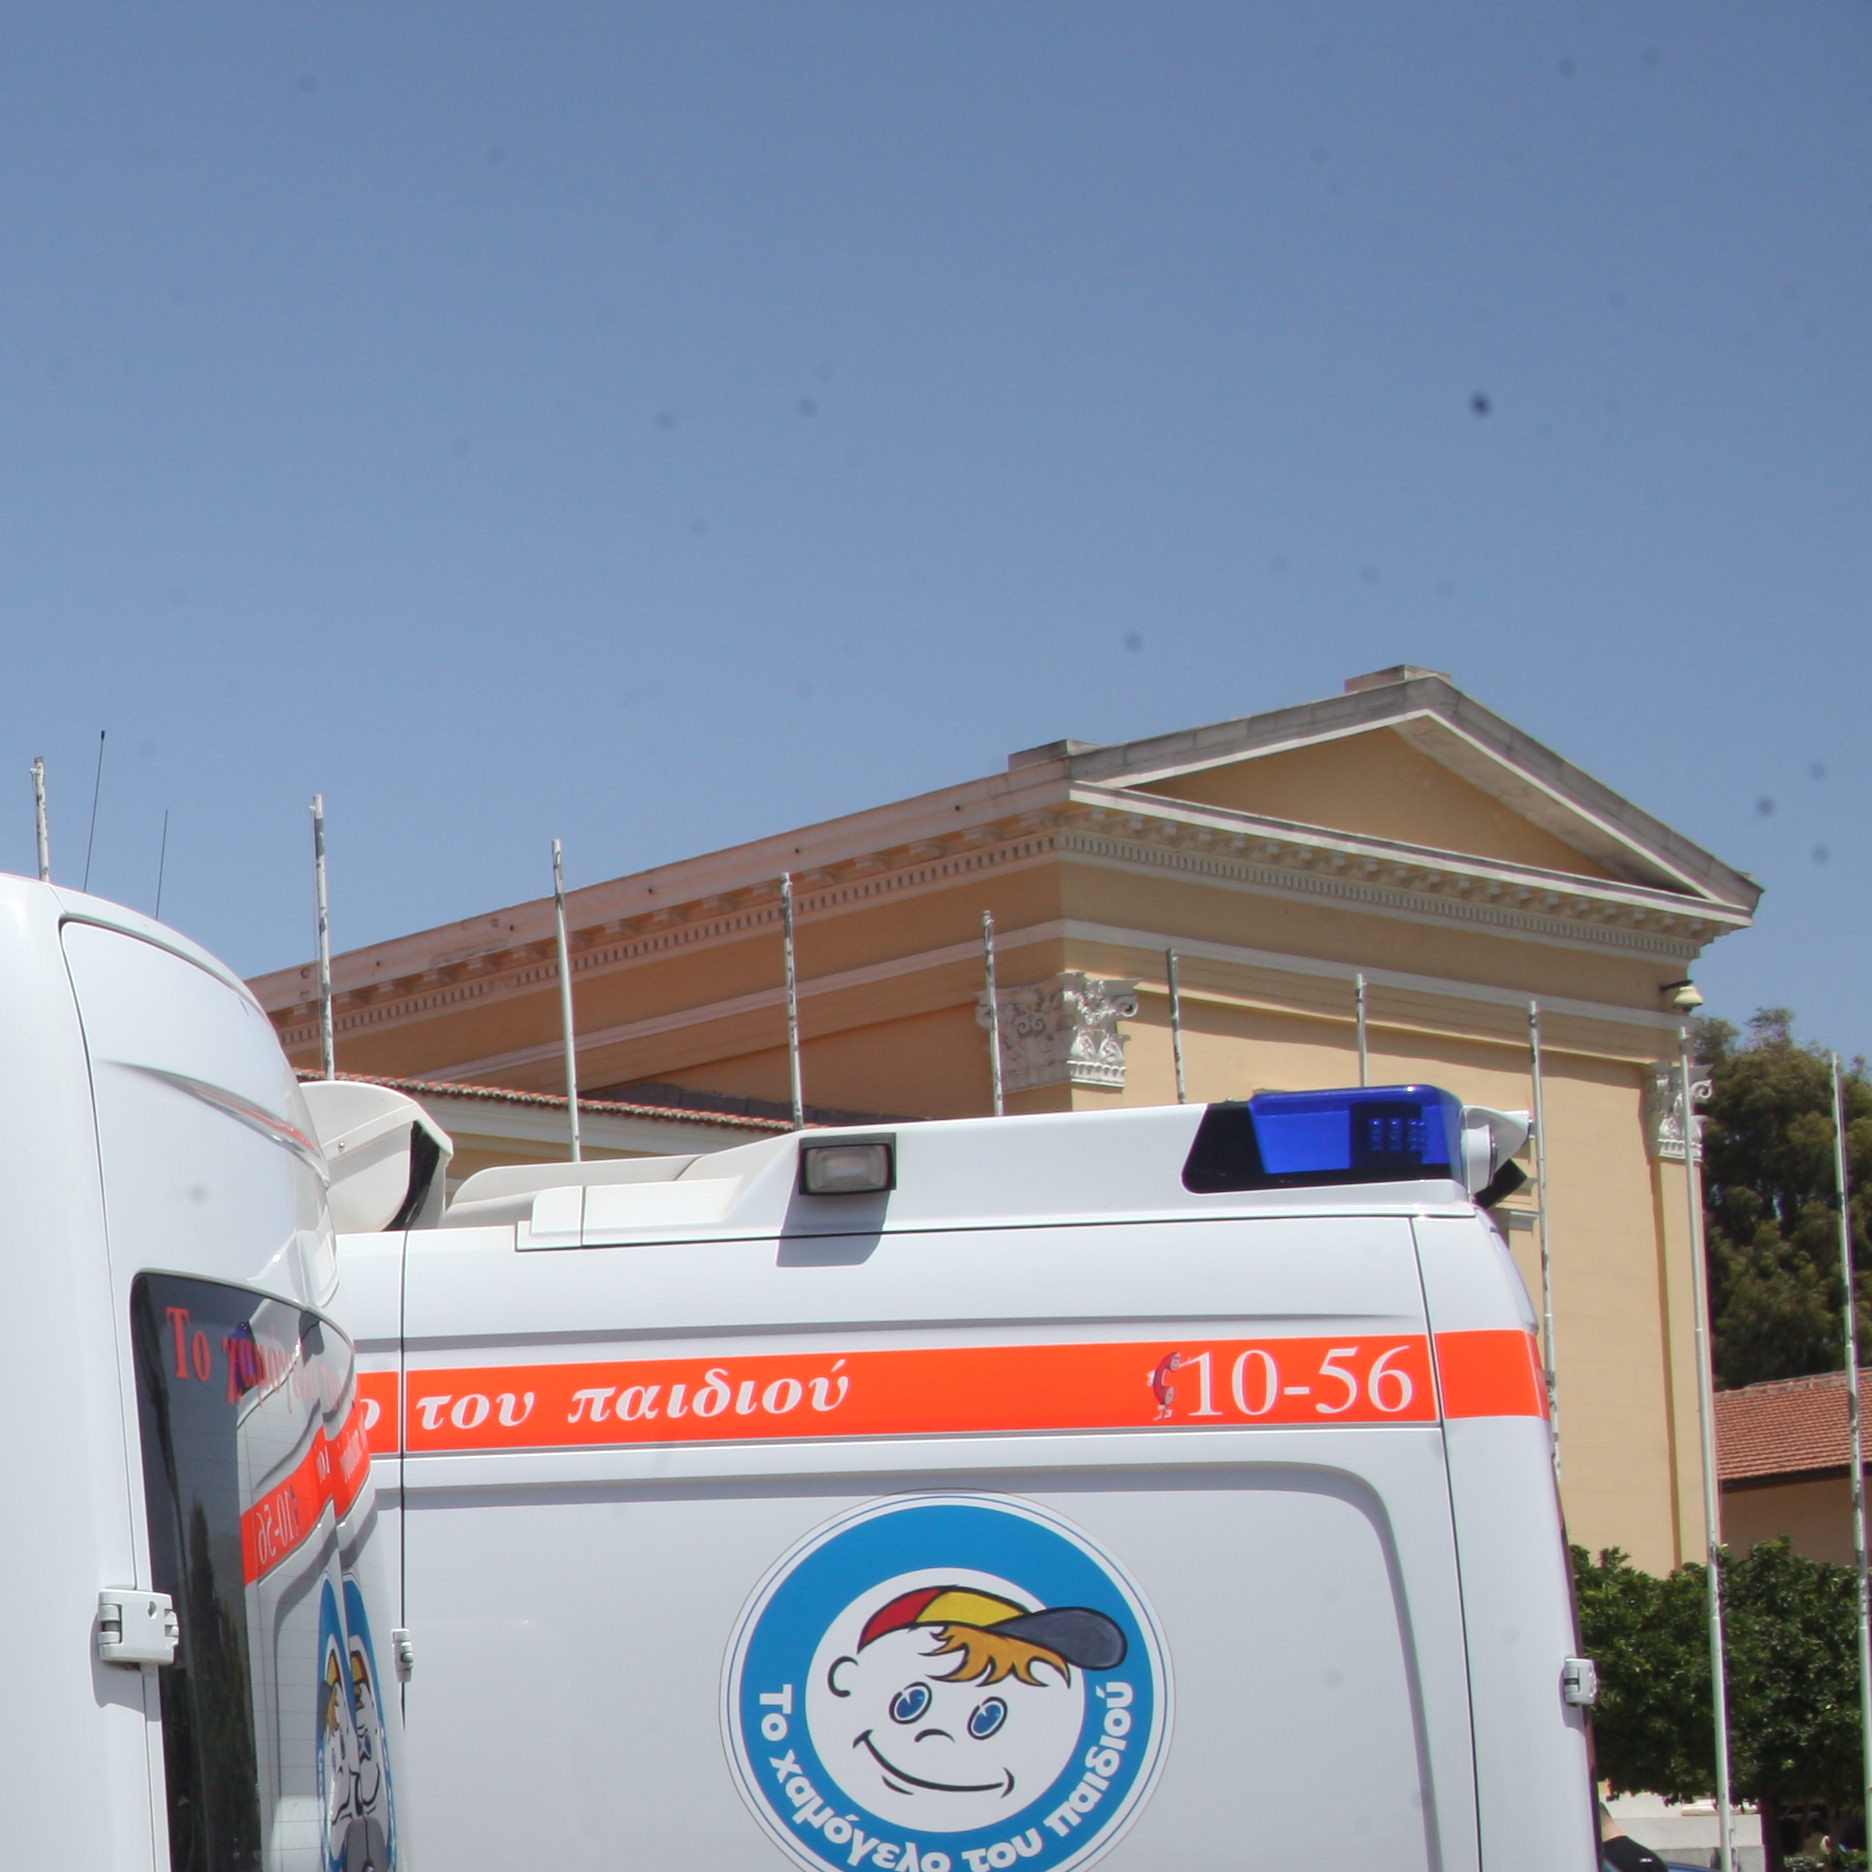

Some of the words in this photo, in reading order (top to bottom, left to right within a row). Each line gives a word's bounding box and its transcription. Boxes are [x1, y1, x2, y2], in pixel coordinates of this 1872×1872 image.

[416, 1391, 536, 1430] του
[568, 1358, 850, 1424] παιδιού
[1187, 1345, 1413, 1416] 10-56
[759, 1683, 792, 1742] Το
[1043, 1681, 1134, 1838] παιδιού
